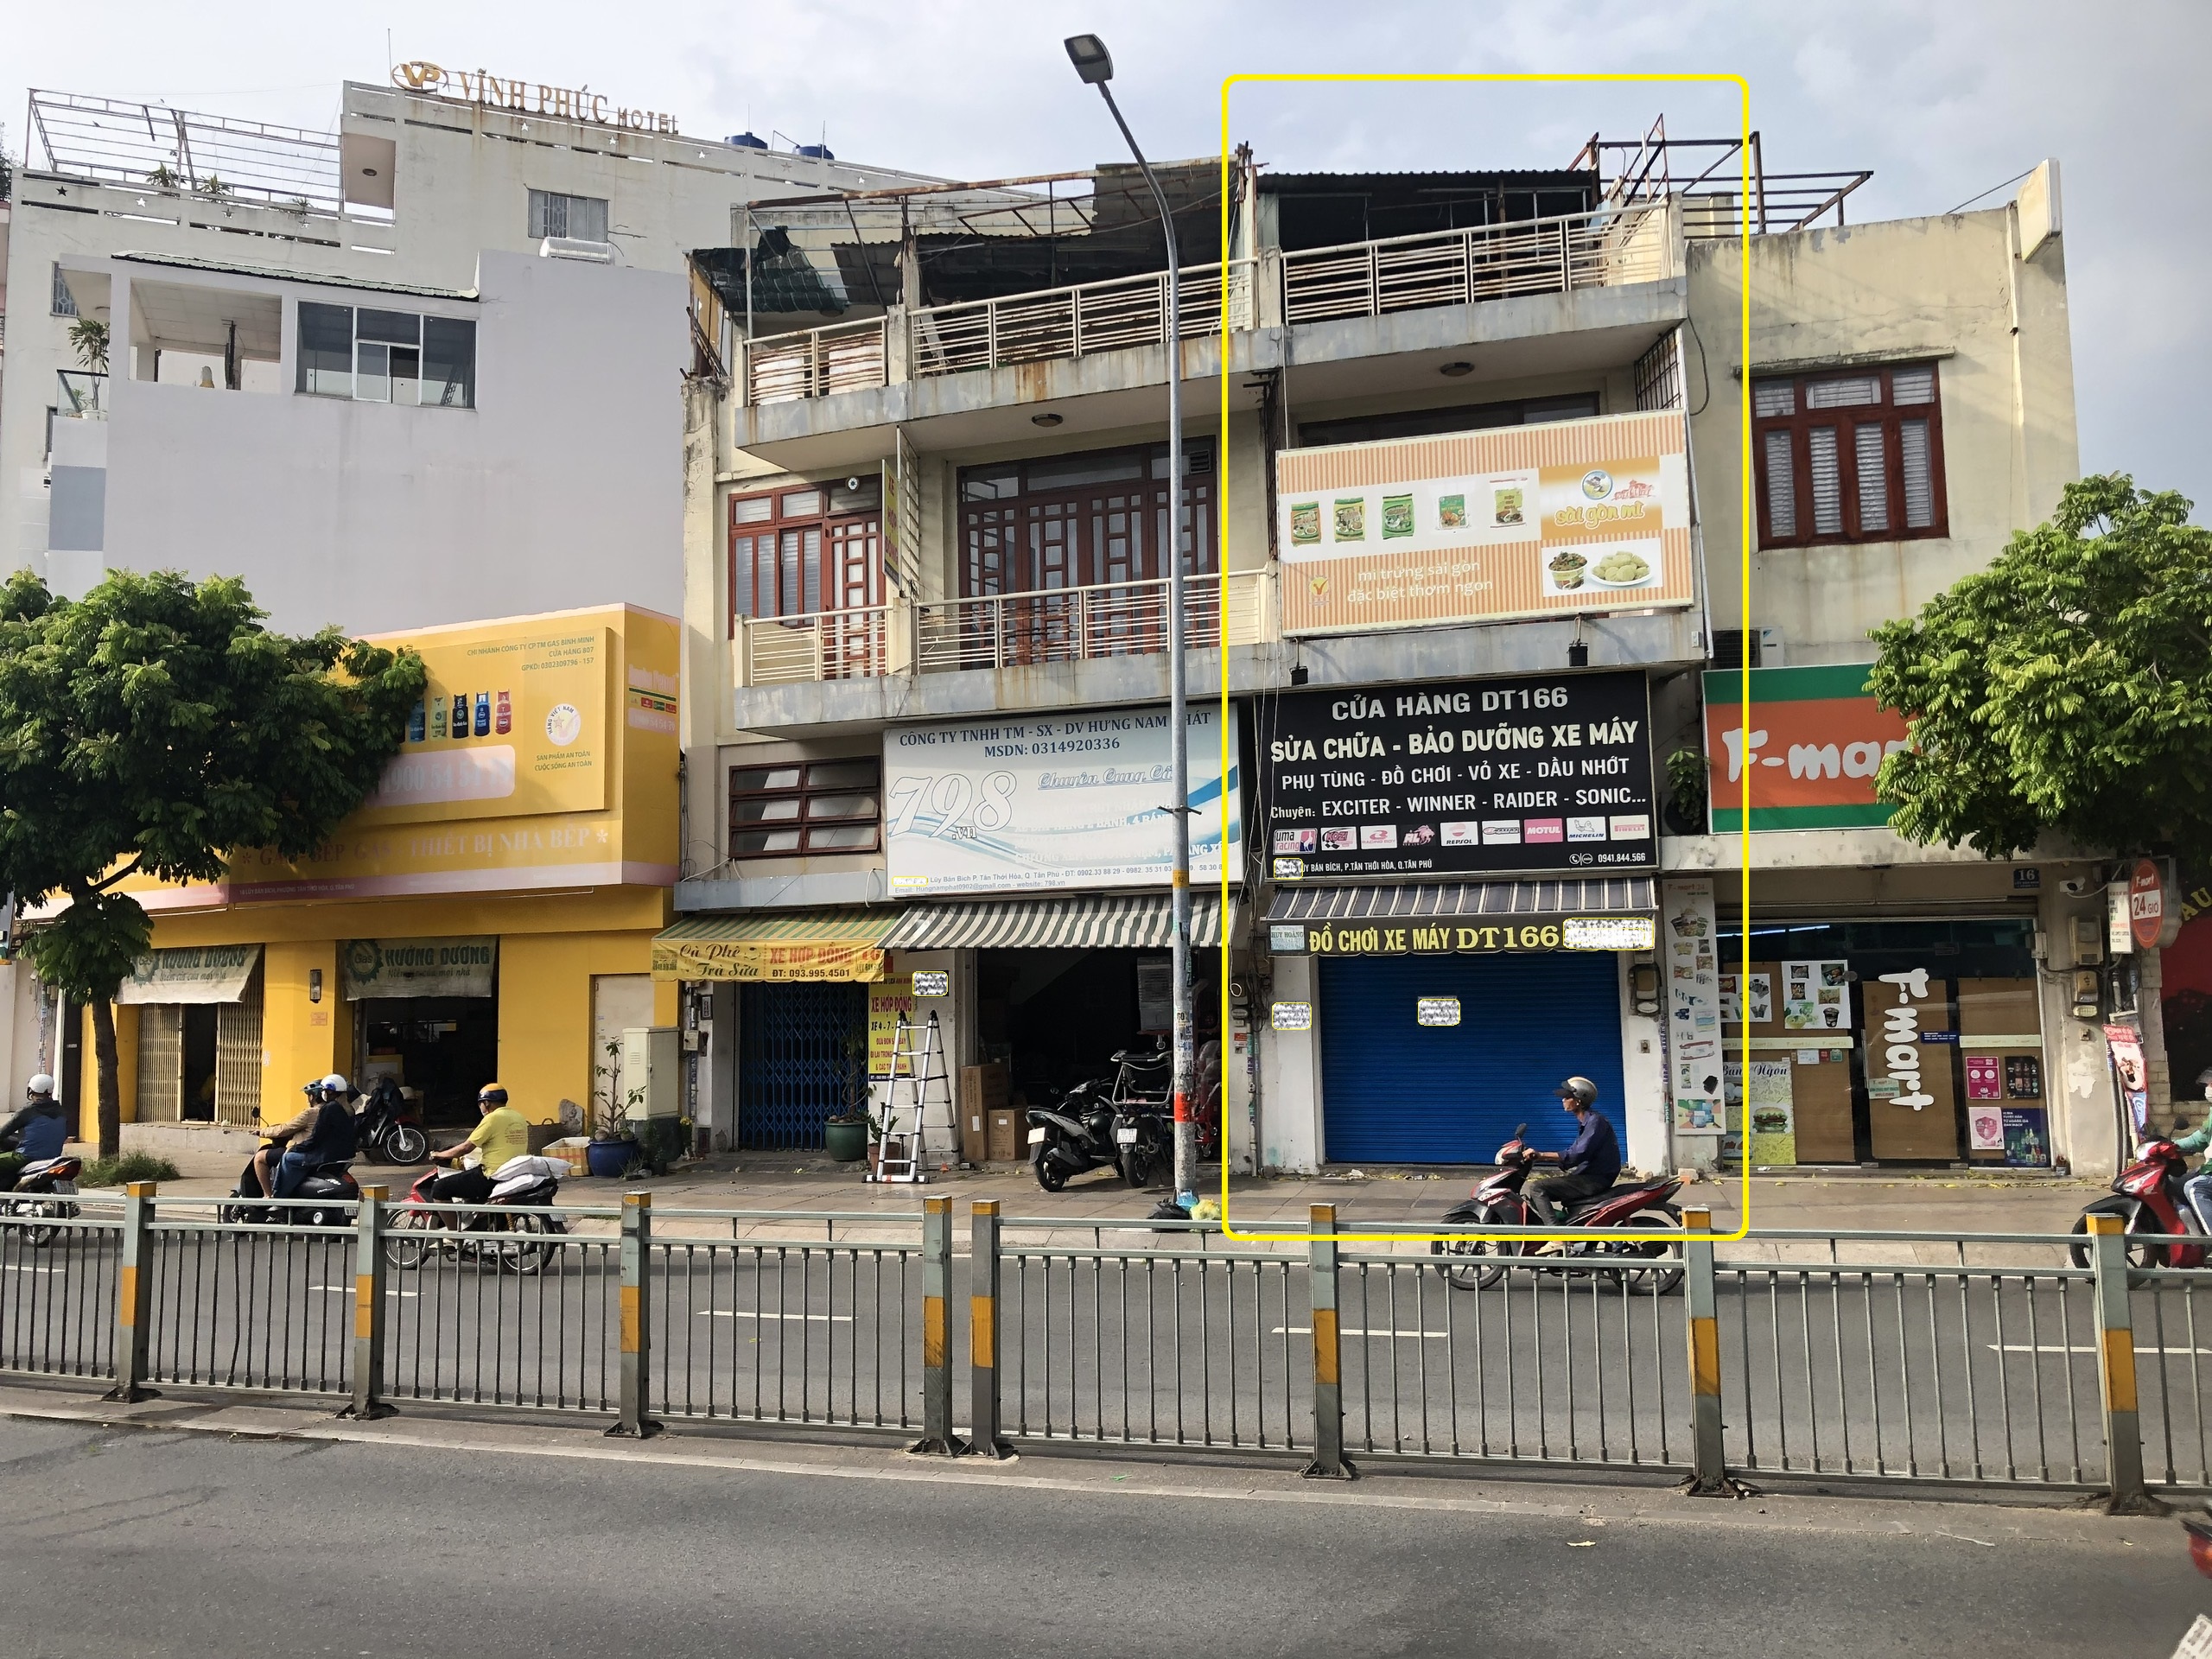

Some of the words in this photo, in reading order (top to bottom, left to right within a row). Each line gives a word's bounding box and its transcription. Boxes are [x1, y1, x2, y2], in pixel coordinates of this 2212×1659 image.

[459, 68, 526, 110] VĨNH
[537, 84, 609, 123] PHÚC
[617, 105, 679, 135] HOTEL
[1555, 505, 1584, 526] sài
[1586, 502, 1618, 530] gòn
[1358, 569, 1376, 581] mì
[1381, 566, 1423, 581] trứng
[1427, 562, 1447, 575] sài
[1452, 560, 1480, 576] gòn
[1348, 588, 1372, 605] đặc
[1376, 584, 1405, 602] biệt
[1408, 582, 1450, 598] thơm
[1455, 580, 1493, 596] ngon
[547, 639, 560, 648] GAS
[577, 635, 594, 645] MINH
[582, 645, 594, 654] 807
[521, 663, 540, 671] GPKD:
[1332, 693, 1386, 721] CỬA
[1396, 691, 1470, 718] HÀNG
[1482, 686, 1568, 712] DT166
[899, 730, 936, 747] CÔNG
[939, 732, 957, 745] TY
[962, 728, 1000, 743] TNHH
[1003, 727, 1025, 741] TM
[1037, 725, 1053, 738] SX
[1065, 722, 1084, 735] DV
[1088, 718, 1130, 734] HƯNG
[1135, 715, 1167, 729] NAM
[1270, 732, 1316, 763] SỬA
[1323, 730, 1386, 760] CHỮA
[1408, 725, 1454, 755] BẢO
[1462, 721, 1544, 752] DƯỠNG
[1551, 723, 1581, 747] XE
[1589, 716, 1638, 746] MÁY
[984, 745, 1028, 759] MSDN:
[1033, 737, 1121, 755] 0314920336
[1038, 772, 1100, 788] Chuyên
[1103, 767, 1147, 785] Cung
[1282, 773, 1314, 792] PHỤ
[1321, 766, 1365, 789] TÙNG
[1382, 764, 1404, 785] ĐỒ
[1411, 765, 1452, 785] CHƠI
[1468, 760, 1492, 781] VỎ
[1498, 762, 1521, 779] XE
[1538, 755, 1572, 778] DẦU
[1580, 756, 1630, 775] NHỚT
[889, 771, 1017, 839] 798
[1271, 805, 1315, 819] Chuyên:
[1322, 798, 1390, 817] EXCITER
[1407, 794, 1476, 813] WINNER
[1493, 791, 1558, 810] RAIDER
[1575, 787, 1646, 806] SONIC...
[1276, 830, 1295, 842] uma
[1526, 825, 1561, 836] MOTUL
[1275, 842, 1300, 852] racing
[1311, 861, 1324, 872] BÁN
[1325, 861, 1343, 872] BÍCH,
[1344, 861, 1363, 871] P.TÂN
[1364, 860, 1380, 870] THỚI
[1381, 860, 1396, 871] HÒA,
[1397, 859, 1417, 869] Q.TÂN
[1419, 858, 1433, 868] PHÚ
[1598, 853, 1646, 863] 0941.844.566
[993, 872, 1007, 880] Thới
[1008, 872, 1023, 880] Hòa,
[1046, 870, 1059, 879] Phú
[2018, 869, 2036, 880] 16
[916, 882, 1011, 893] Hungnamphat0902@gmail.com
[1017, 880, 1043, 889] website:
[2133, 895, 2146, 916] 24
[1309, 922, 1333, 952] ĐỒ
[1338, 926, 1379, 951] CHƠI
[1384, 929, 1406, 950] XE
[1413, 923, 1452, 950] MÁY
[1456, 925, 1560, 950] DT166
[354, 953, 372, 964] Gas
[385, 945, 434, 966] HƯỚNG
[440, 945, 490, 965] DƯƠNG
[679, 944, 700, 957] Cà
[706, 943, 741, 960] Phê
[770, 948, 785, 965] XE
[789, 946, 814, 967] HỢP
[817, 942, 852, 964] ĐỒNG
[455, 967, 470, 976] nhà
[696, 962, 724, 976] Trà
[728, 962, 758, 976] Sữa
[789, 969, 850, 978] 093.995.4501
[871, 996, 880, 1013] XE
[881, 993, 893, 1017] HỢP
[1878, 968, 1935, 1111] F-mart
[1754, 1065, 1787, 1077] Ngon
